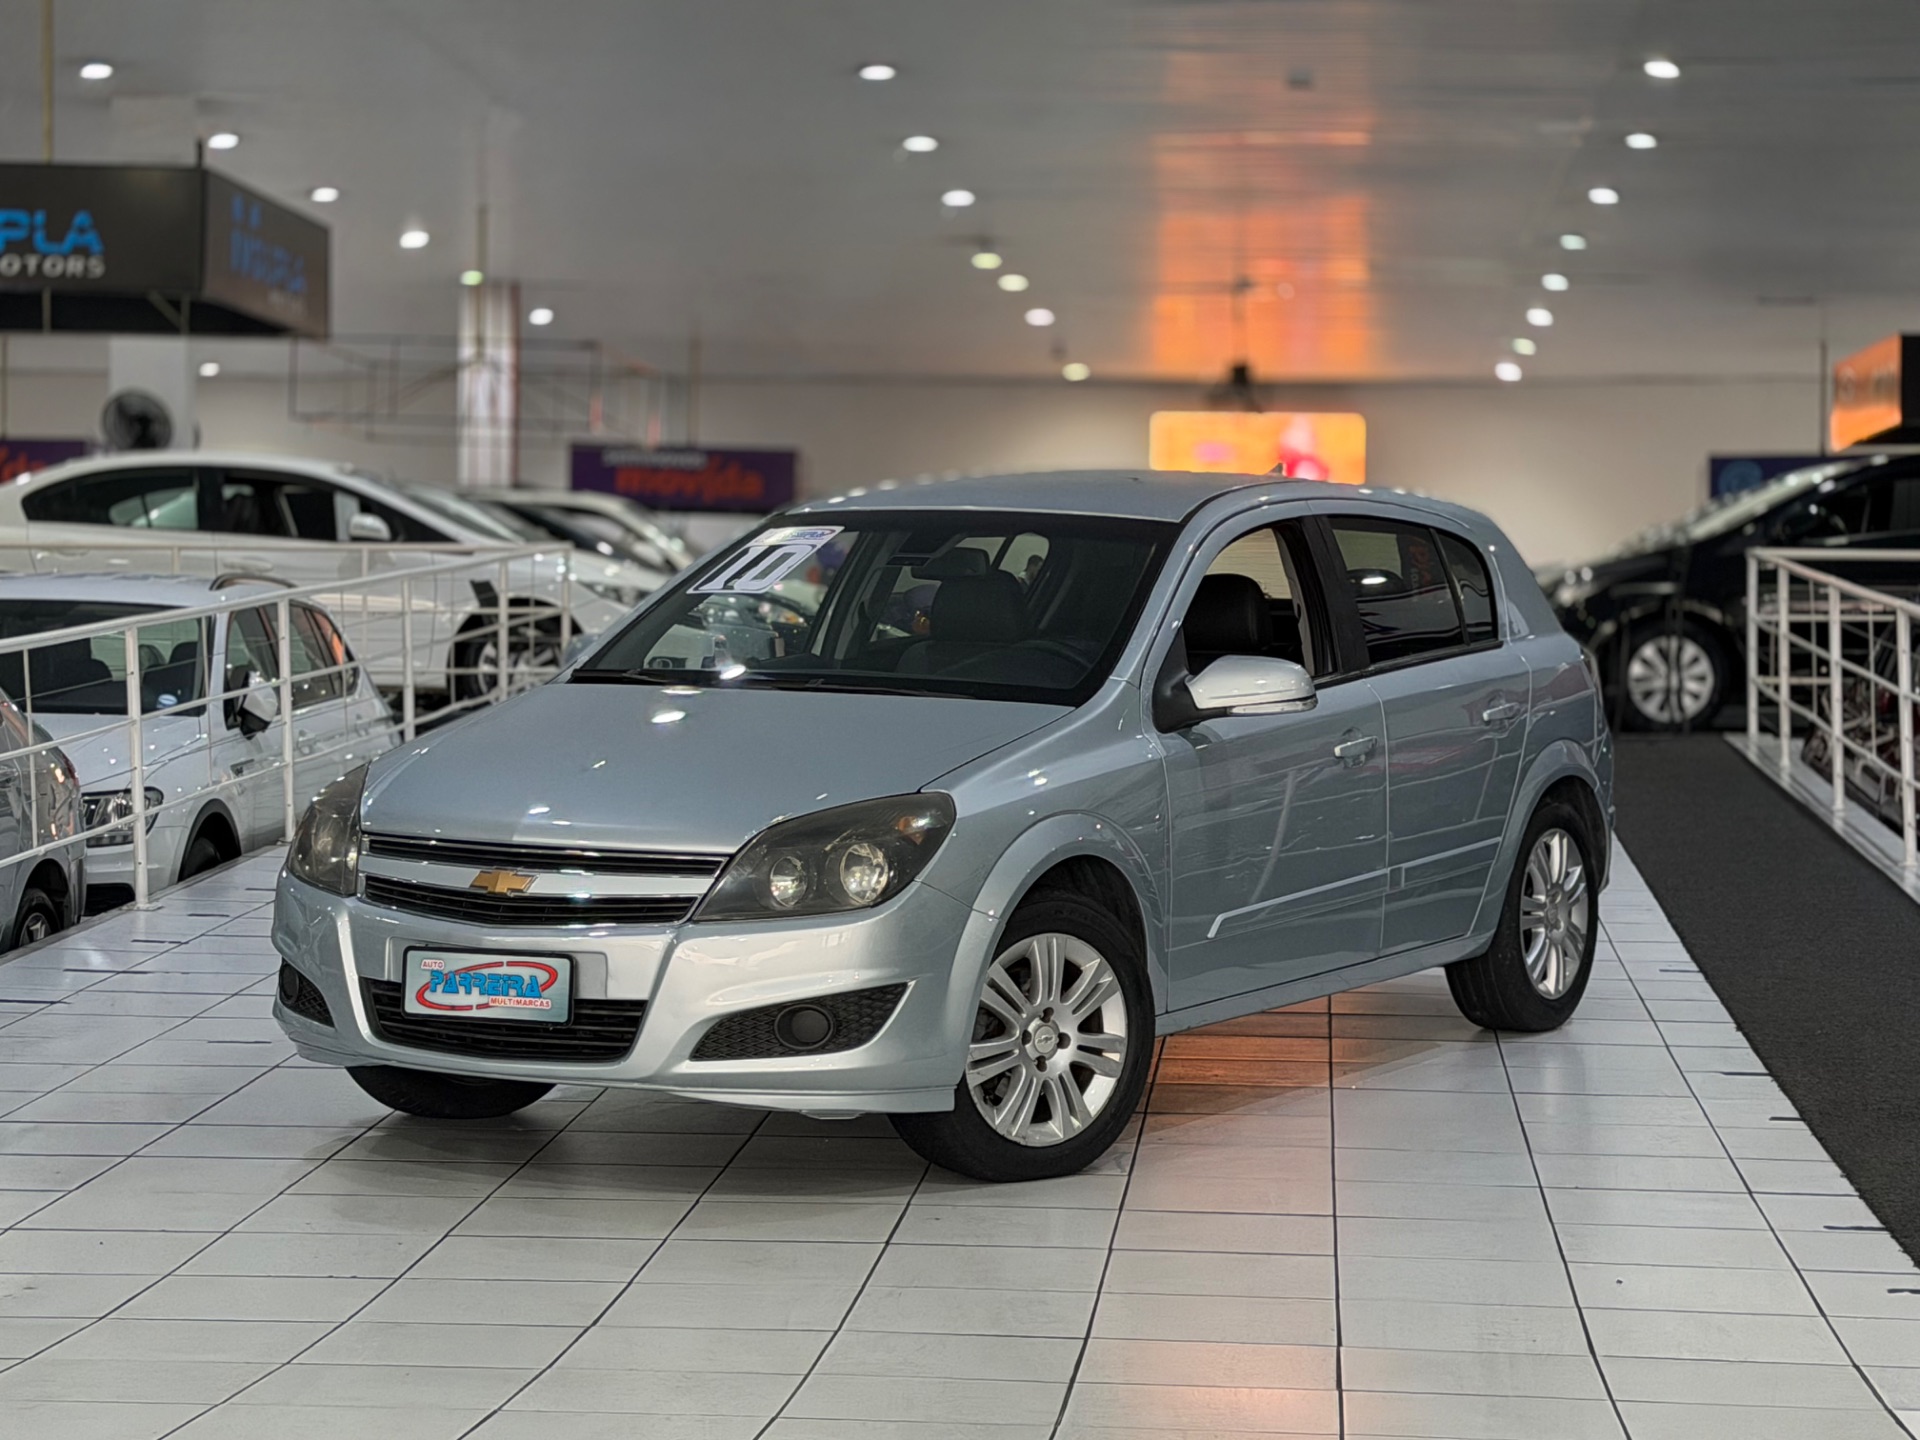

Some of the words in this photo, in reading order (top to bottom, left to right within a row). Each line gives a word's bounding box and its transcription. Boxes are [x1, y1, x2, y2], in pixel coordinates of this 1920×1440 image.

[695, 545, 816, 591] 10
[430, 971, 542, 997] PARREIRA
[491, 998, 550, 1008] MULTIMARCAS
